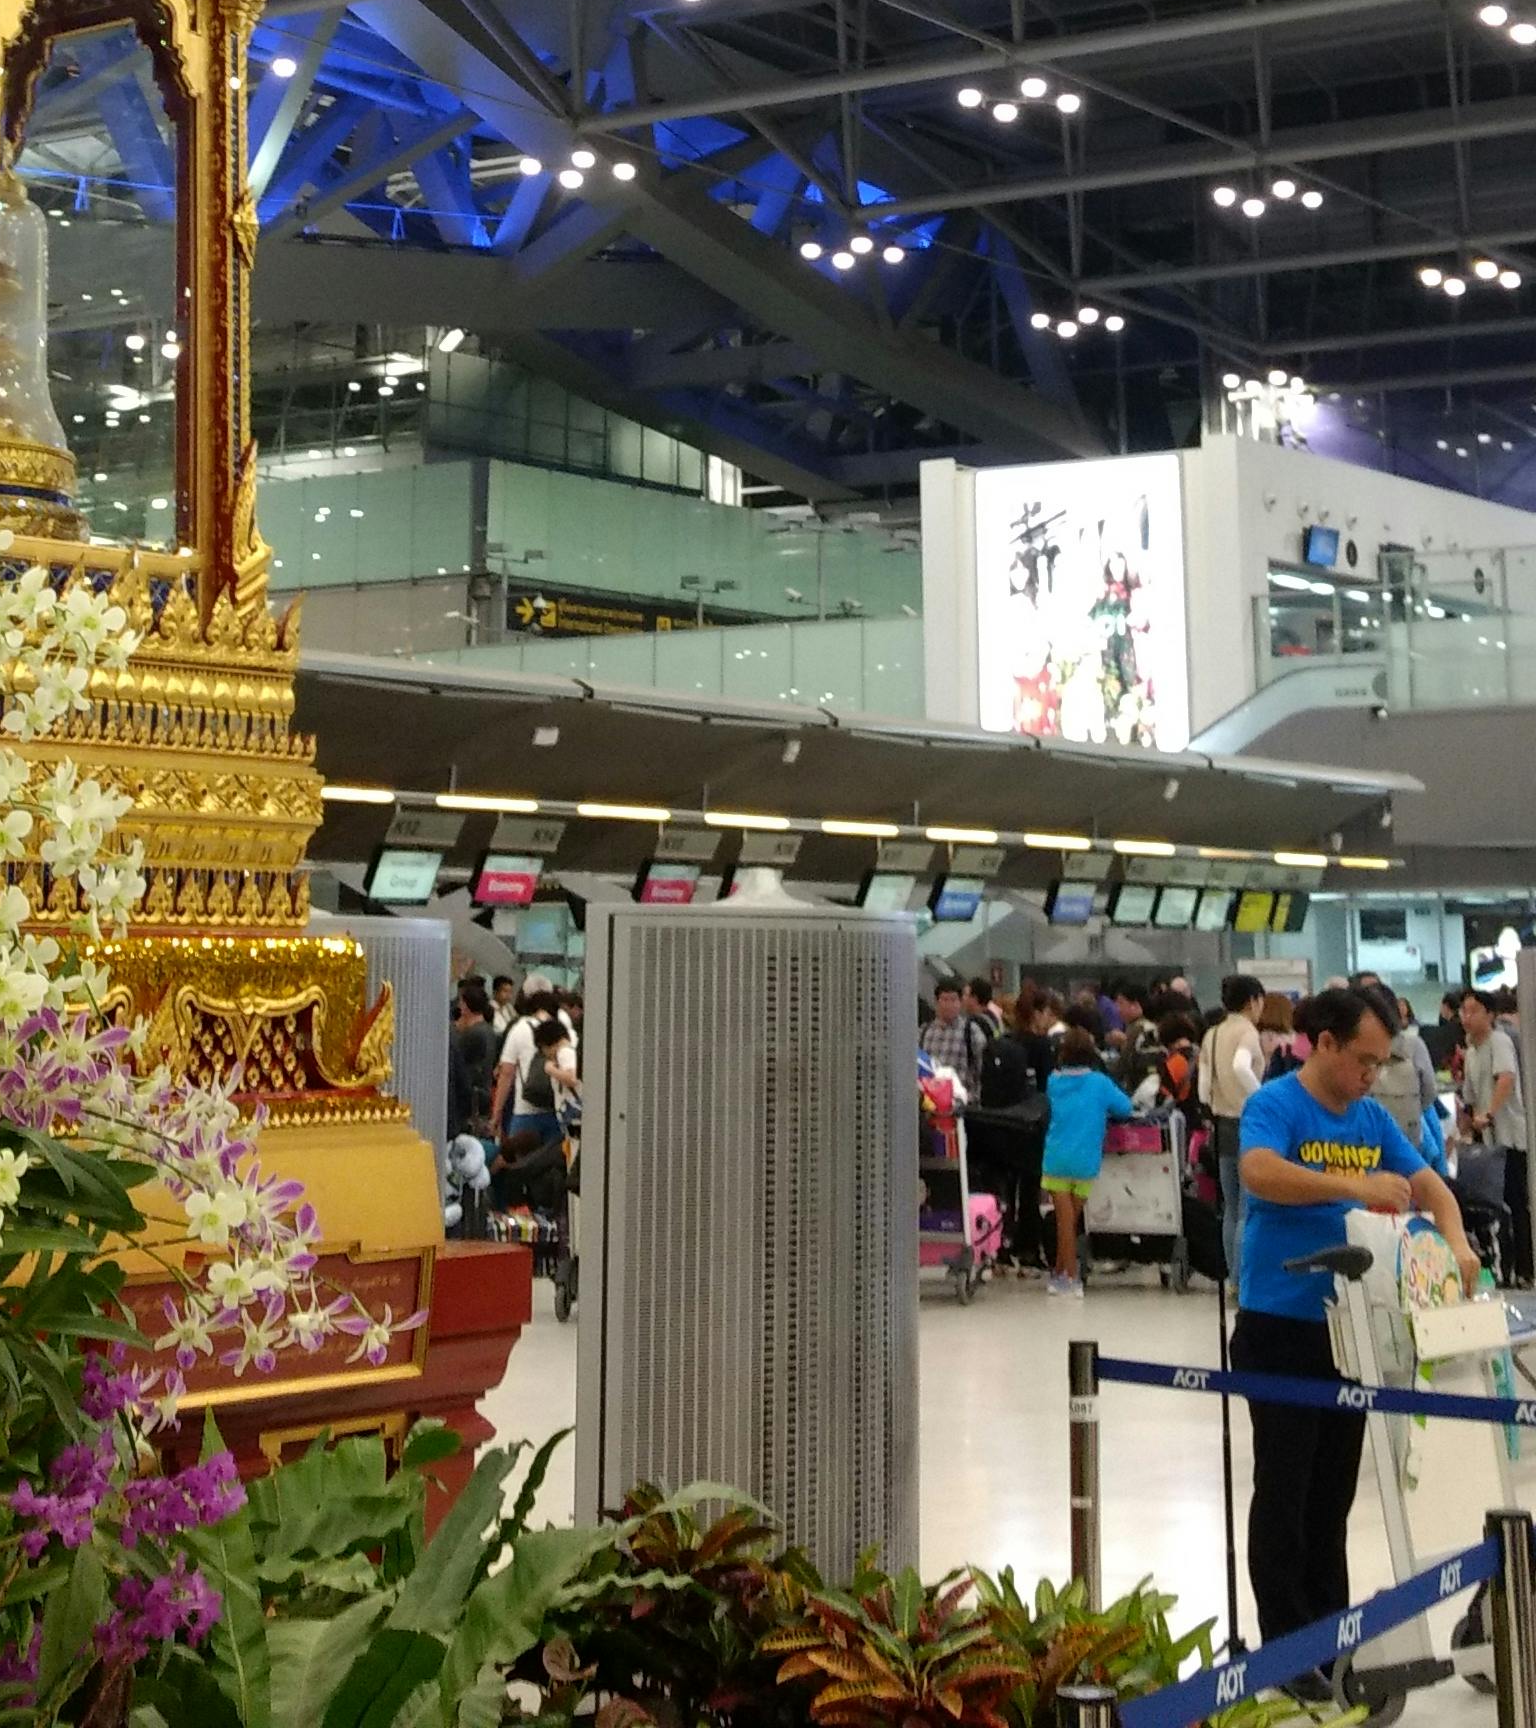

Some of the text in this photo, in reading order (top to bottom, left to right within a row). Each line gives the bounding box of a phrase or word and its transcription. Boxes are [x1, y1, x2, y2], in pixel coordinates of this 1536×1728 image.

[1299, 1140, 1382, 1169] JOURNEY
[1171, 1368, 1210, 1390] AOT
[1336, 1385, 1378, 1409] AOT
[1439, 1559, 1462, 1597] AOT
[1336, 1609, 1363, 1650] AOT
[1216, 1660, 1247, 1706] AOT
